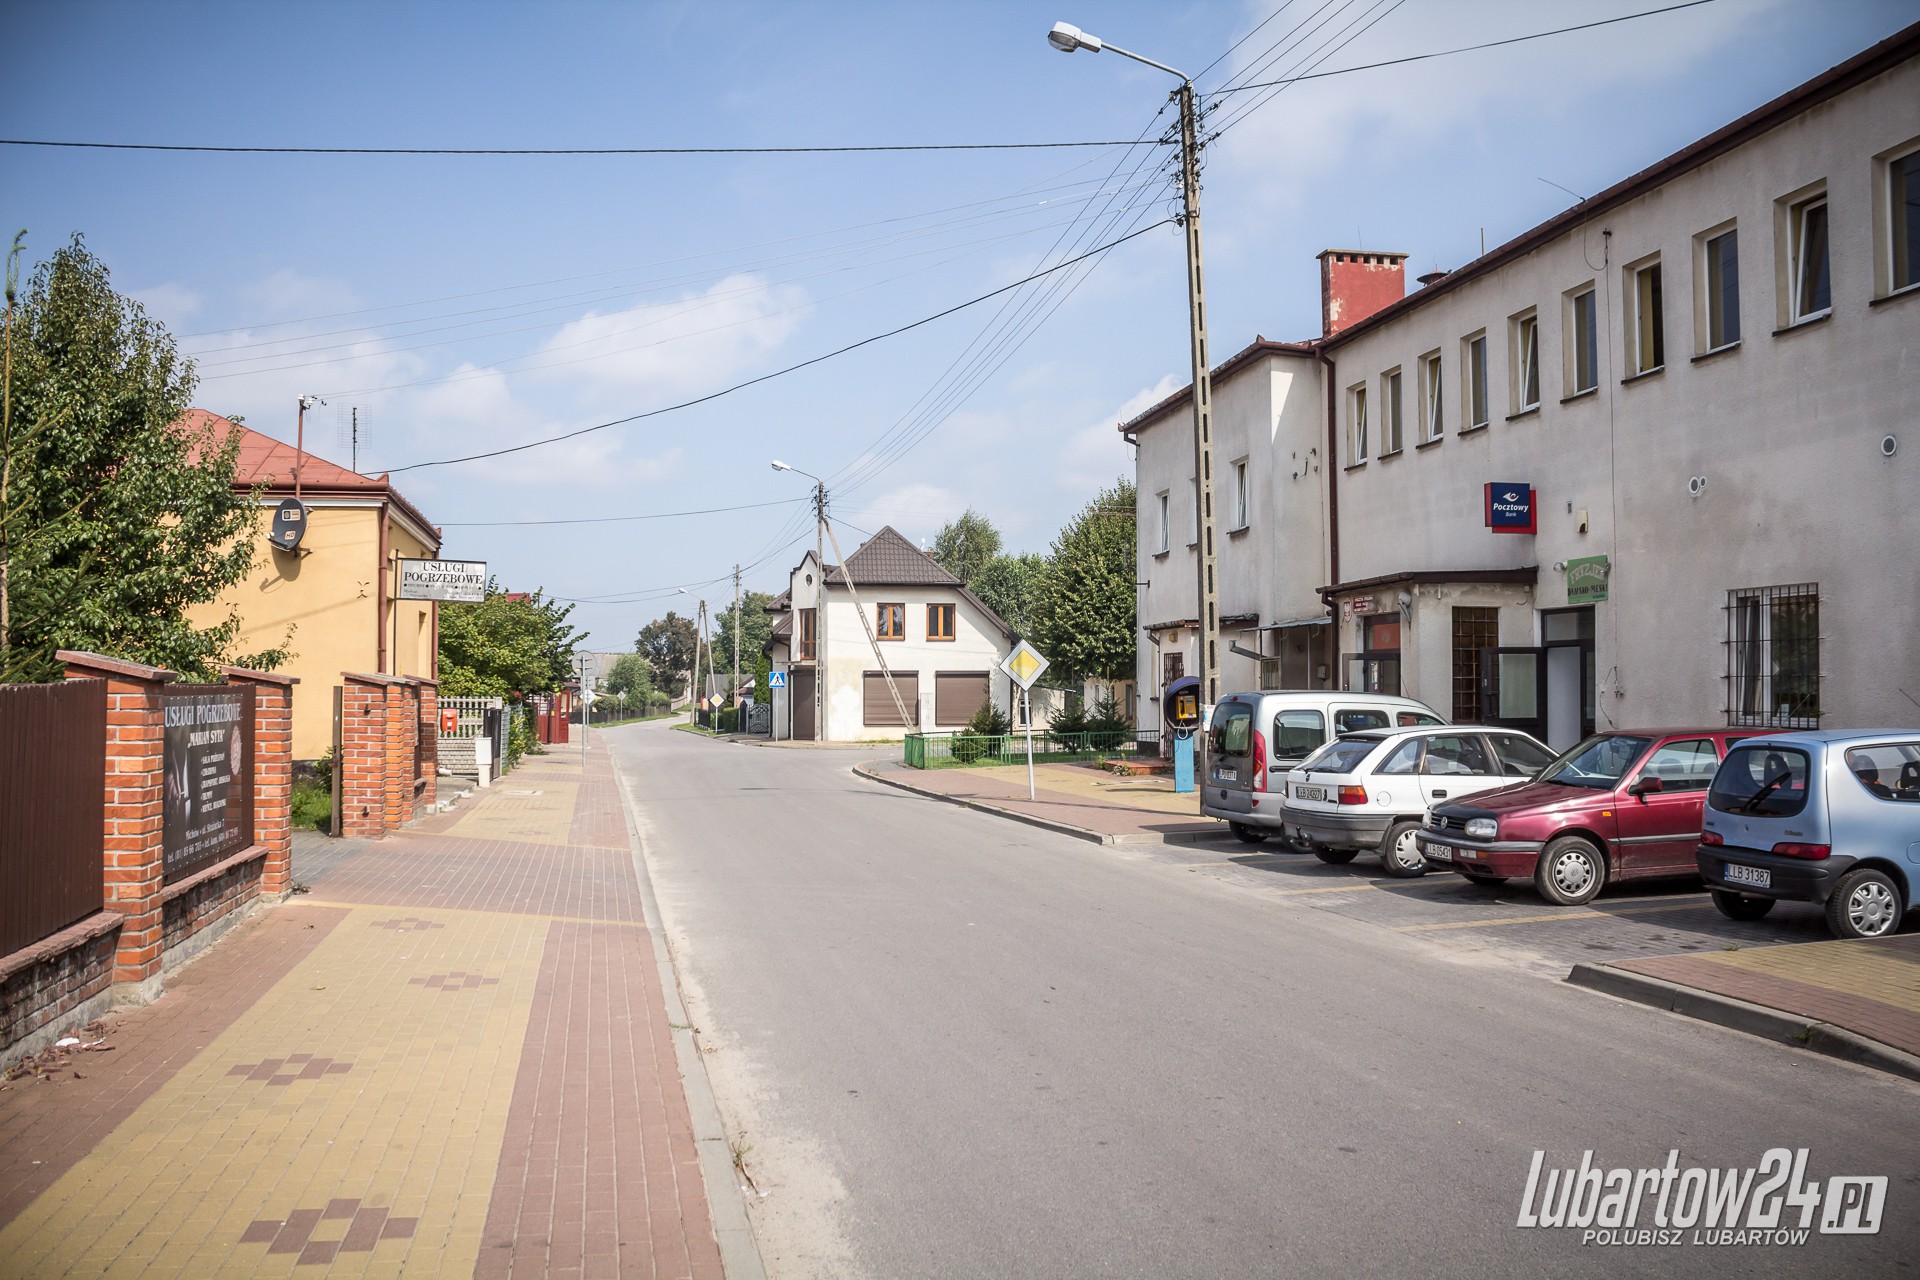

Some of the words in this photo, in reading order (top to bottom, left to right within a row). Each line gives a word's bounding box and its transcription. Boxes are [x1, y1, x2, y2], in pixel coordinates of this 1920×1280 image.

[1493, 503, 1529, 513] Pocztowy
[423, 562, 465, 573] USŁUGI
[404, 572, 483, 584] POGRZEBOWE
[165, 706, 194, 727] USŁUGI
[197, 703, 241, 724] POGRZEBOWE
[1729, 865, 1743, 879] LLB
[1745, 868, 1769, 883] 31387
